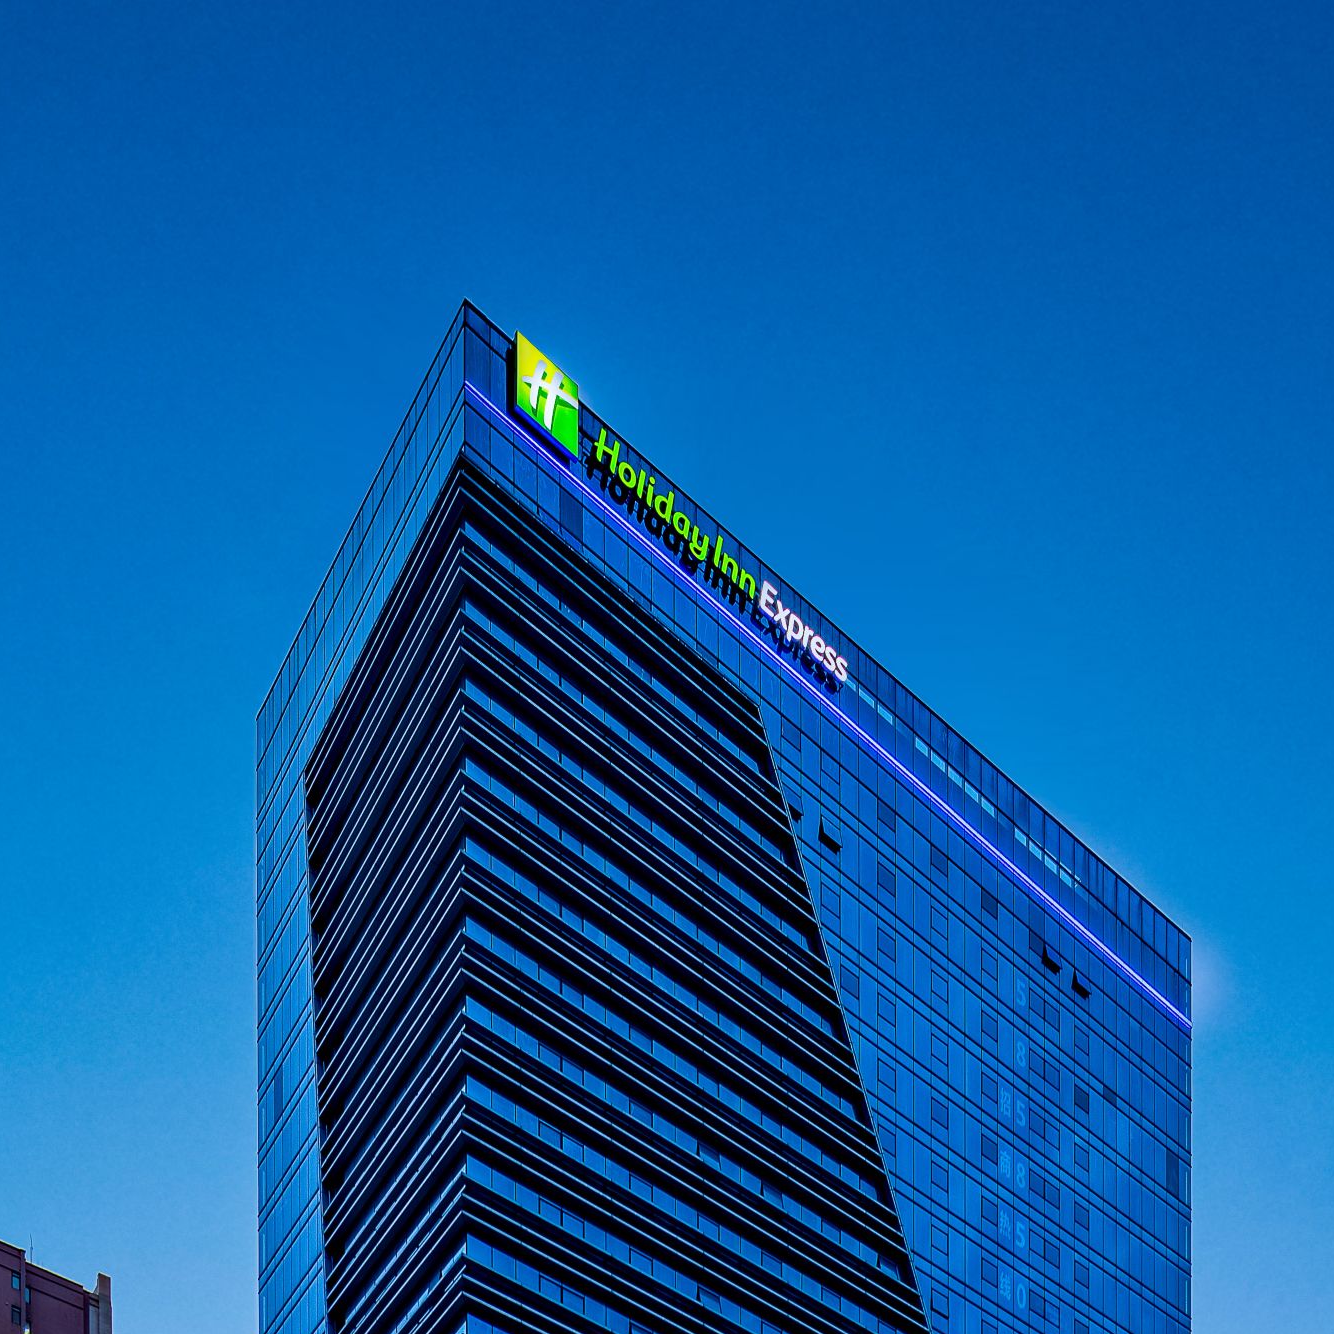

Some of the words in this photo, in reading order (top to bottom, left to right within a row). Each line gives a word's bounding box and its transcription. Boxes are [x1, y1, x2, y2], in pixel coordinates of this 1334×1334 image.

[594, 428, 709, 561] Holiday
[713, 535, 756, 599] Inn
[760, 580, 848, 682] Express
